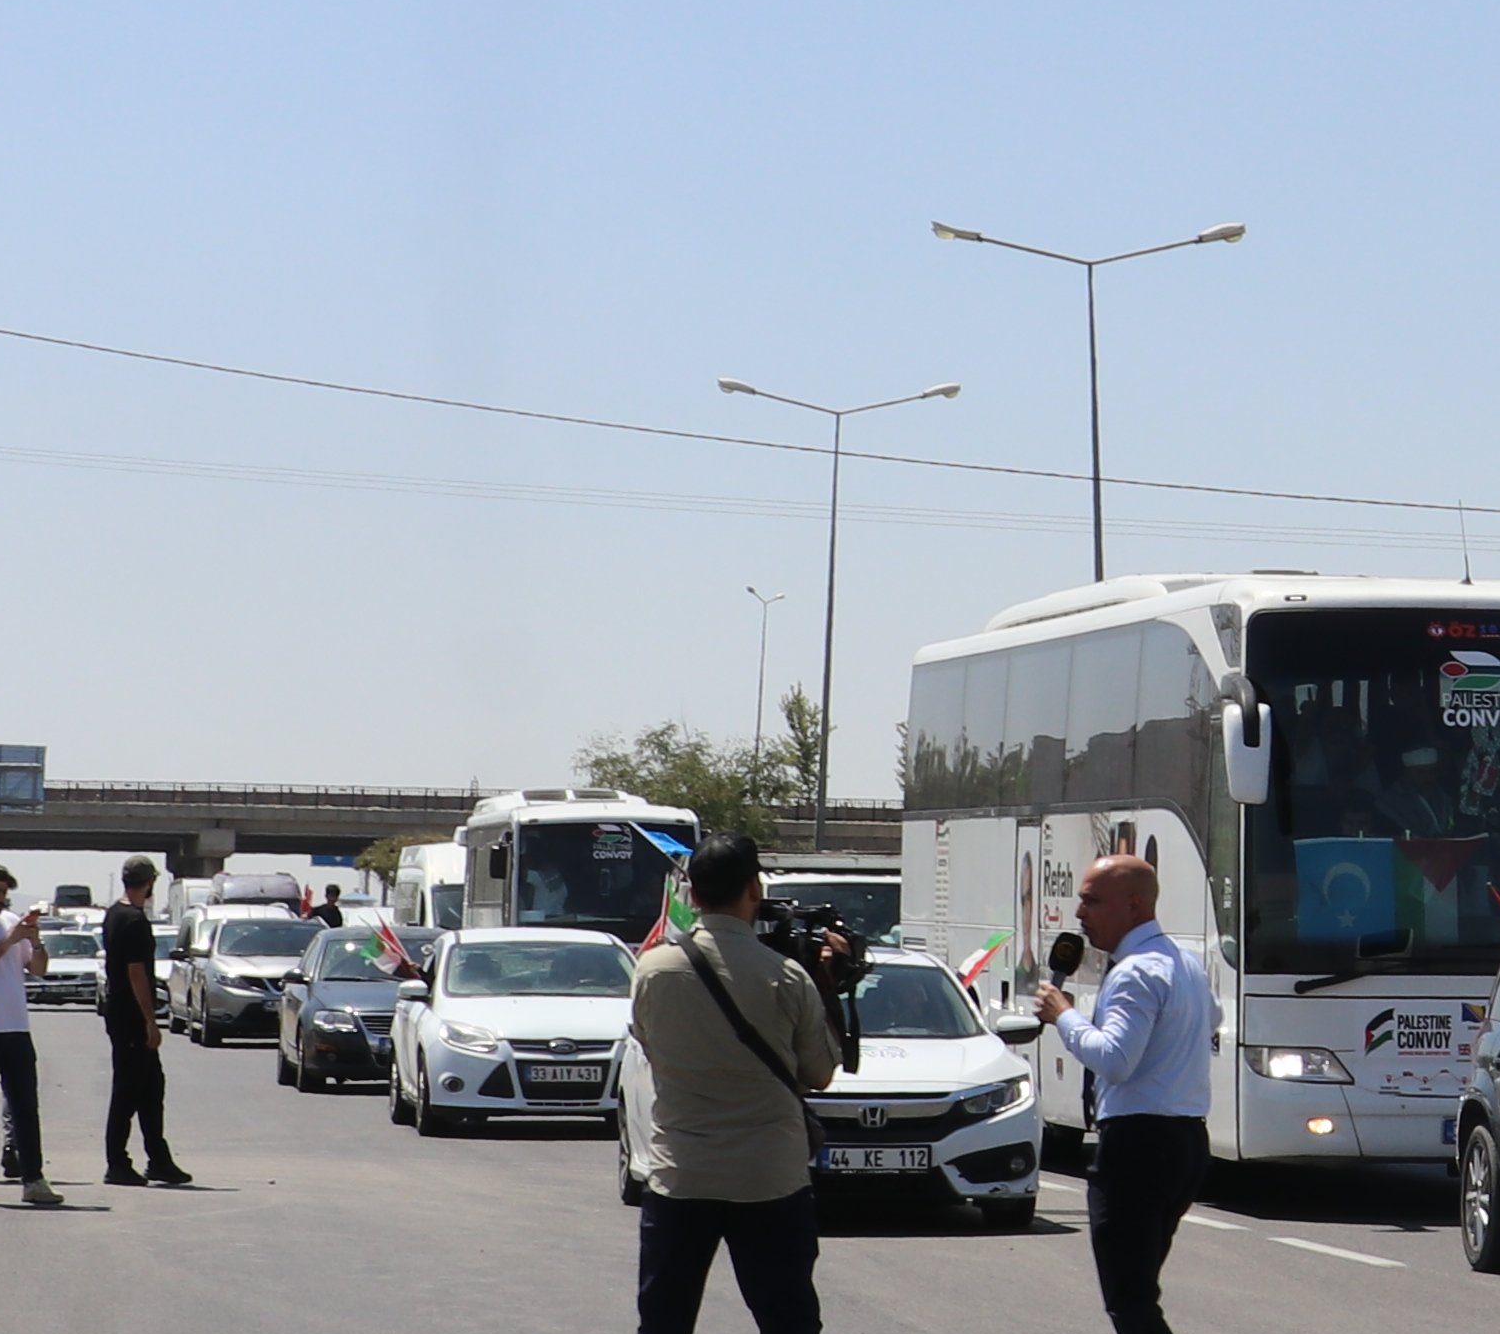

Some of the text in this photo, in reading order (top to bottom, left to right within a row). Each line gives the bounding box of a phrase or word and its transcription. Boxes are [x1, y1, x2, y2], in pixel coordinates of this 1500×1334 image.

[592, 850, 633, 859] CONVOY
[1044, 860, 1073, 898] Refah
[1397, 1015, 1452, 1030] PALESTINE
[1397, 1031, 1451, 1049] CONVOY
[532, 1068, 546, 1080] 33
[578, 1068, 598, 1080] 431
[831, 1150, 850, 1167] 44
[864, 1150, 883, 1167] KE
[900, 1150, 927, 1167] 112
